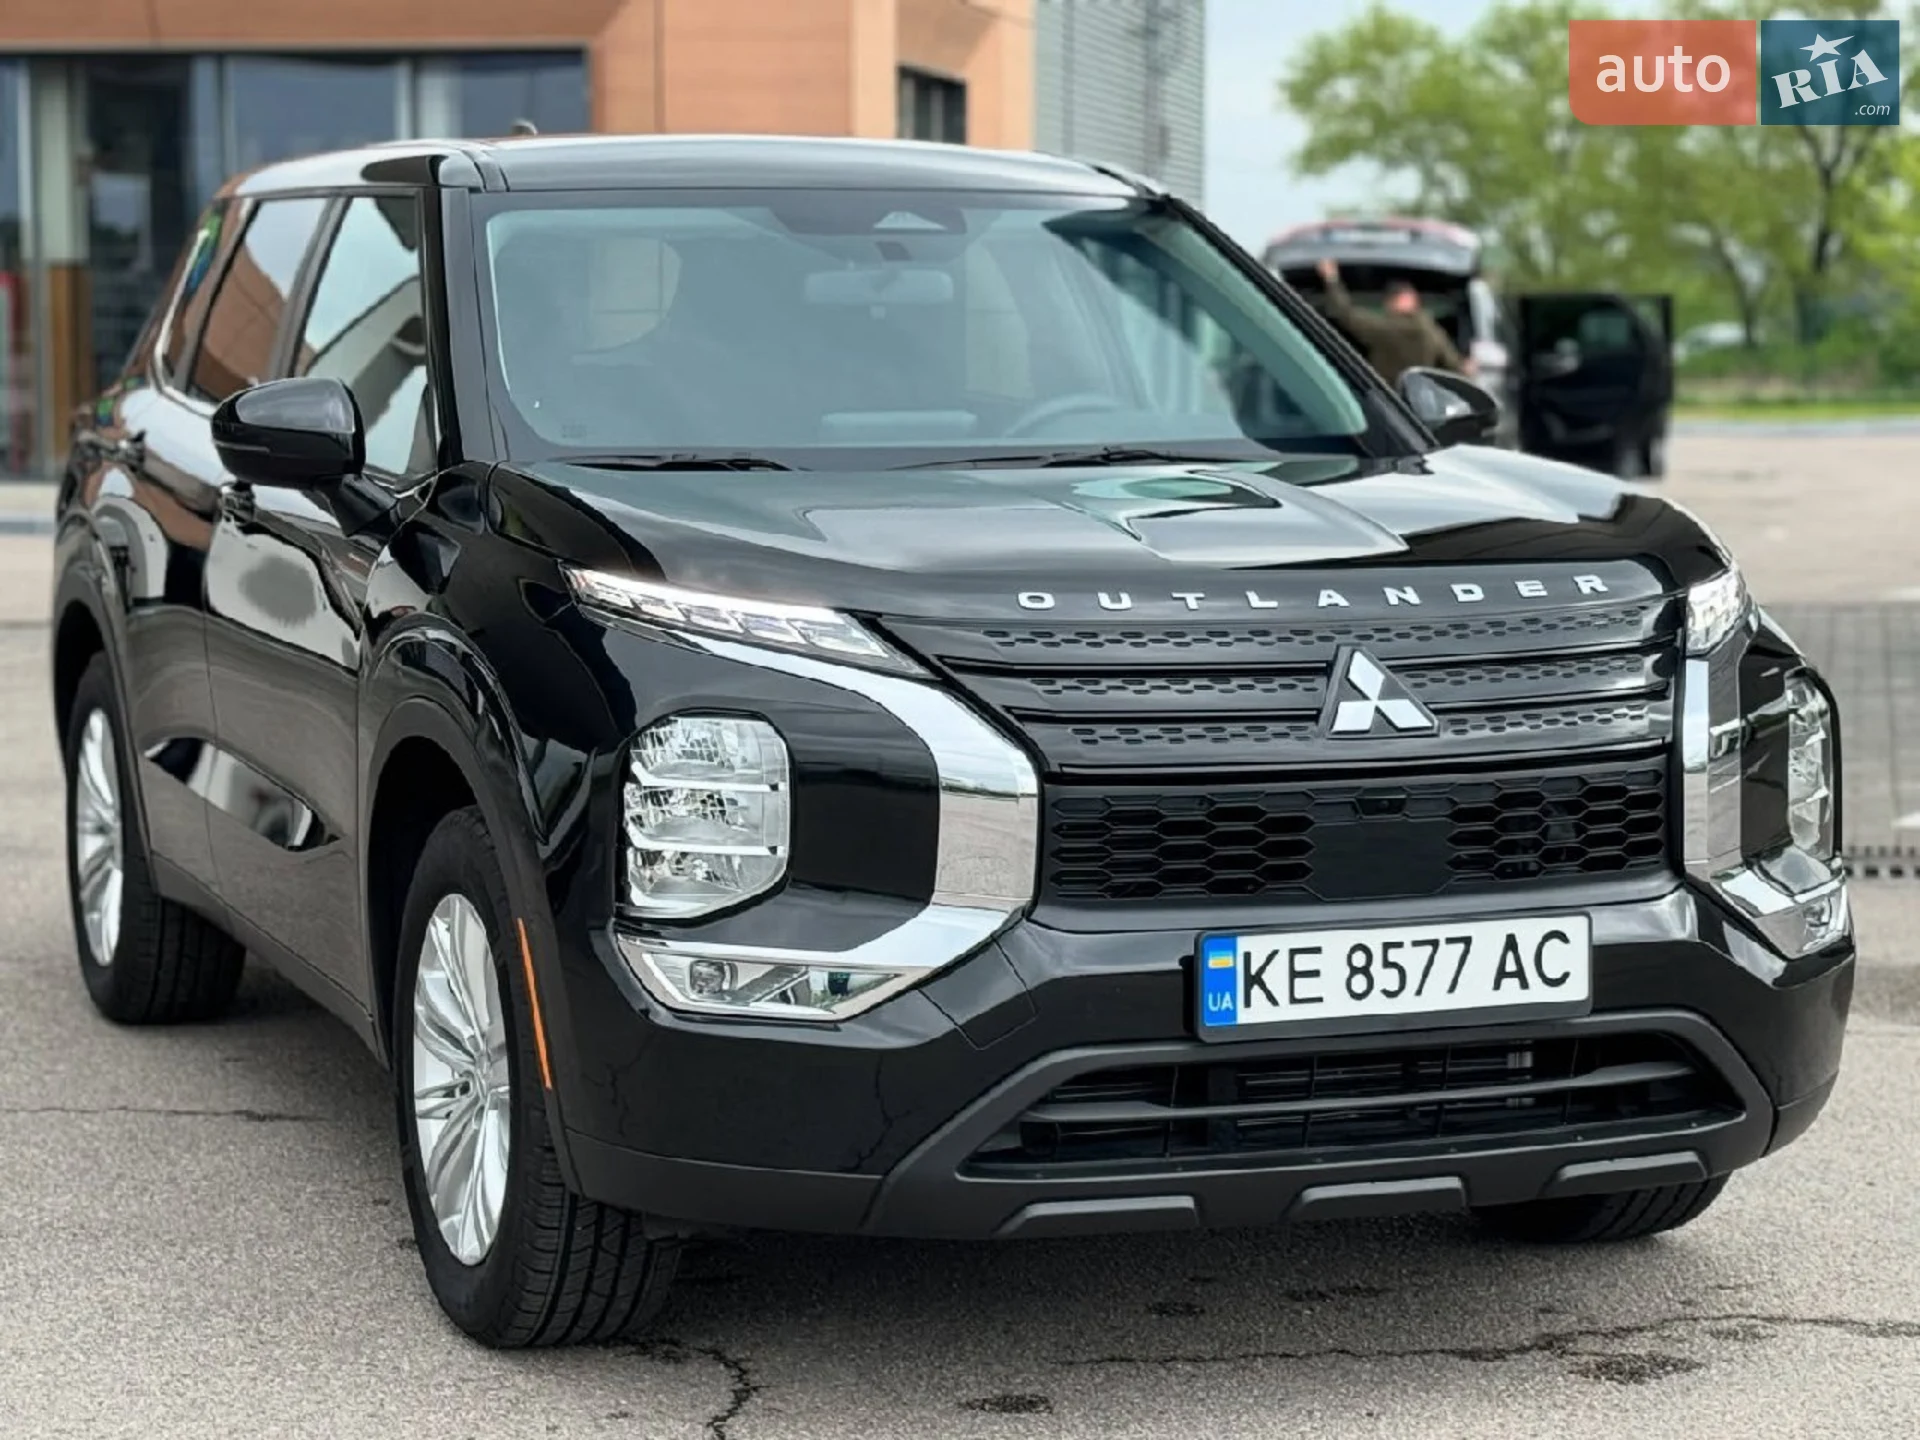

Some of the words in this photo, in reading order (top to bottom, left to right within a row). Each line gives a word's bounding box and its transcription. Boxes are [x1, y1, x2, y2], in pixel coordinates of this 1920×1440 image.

[1017, 574, 1609, 610] OUTLANDER
[1243, 946, 1324, 1009] KE
[1345, 935, 1473, 1001] 8577
[1492, 929, 1571, 991] AC
[1208, 991, 1234, 1012] UA
